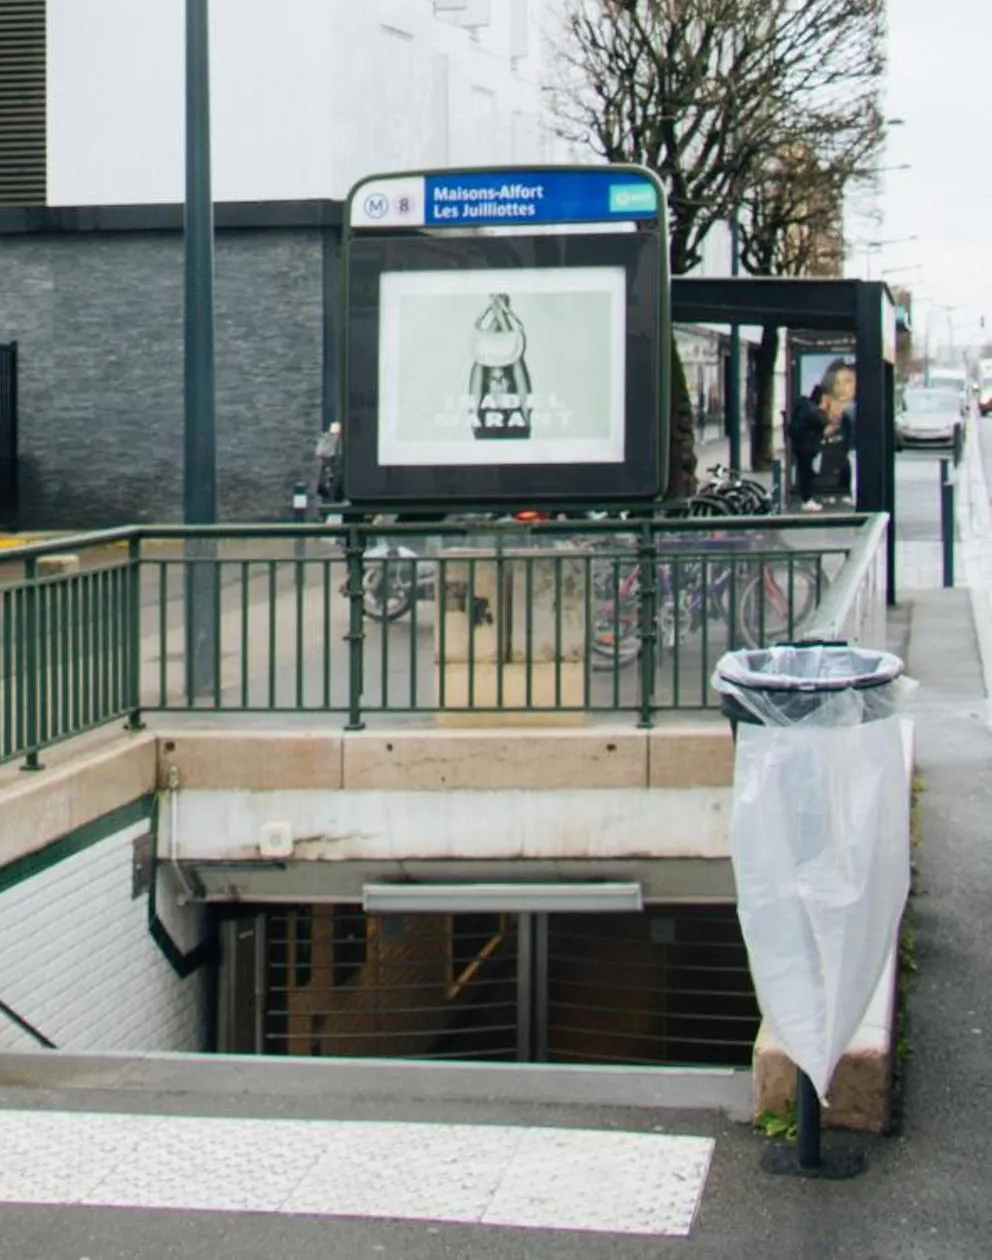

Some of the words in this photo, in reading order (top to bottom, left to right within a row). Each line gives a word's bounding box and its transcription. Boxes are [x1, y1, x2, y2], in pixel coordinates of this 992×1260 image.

[433, 185, 544, 201] Maisons-Alfort
[399, 197, 409, 212] 8
[433, 205, 458, 218] Les
[462, 202, 535, 217] Juilliottes
